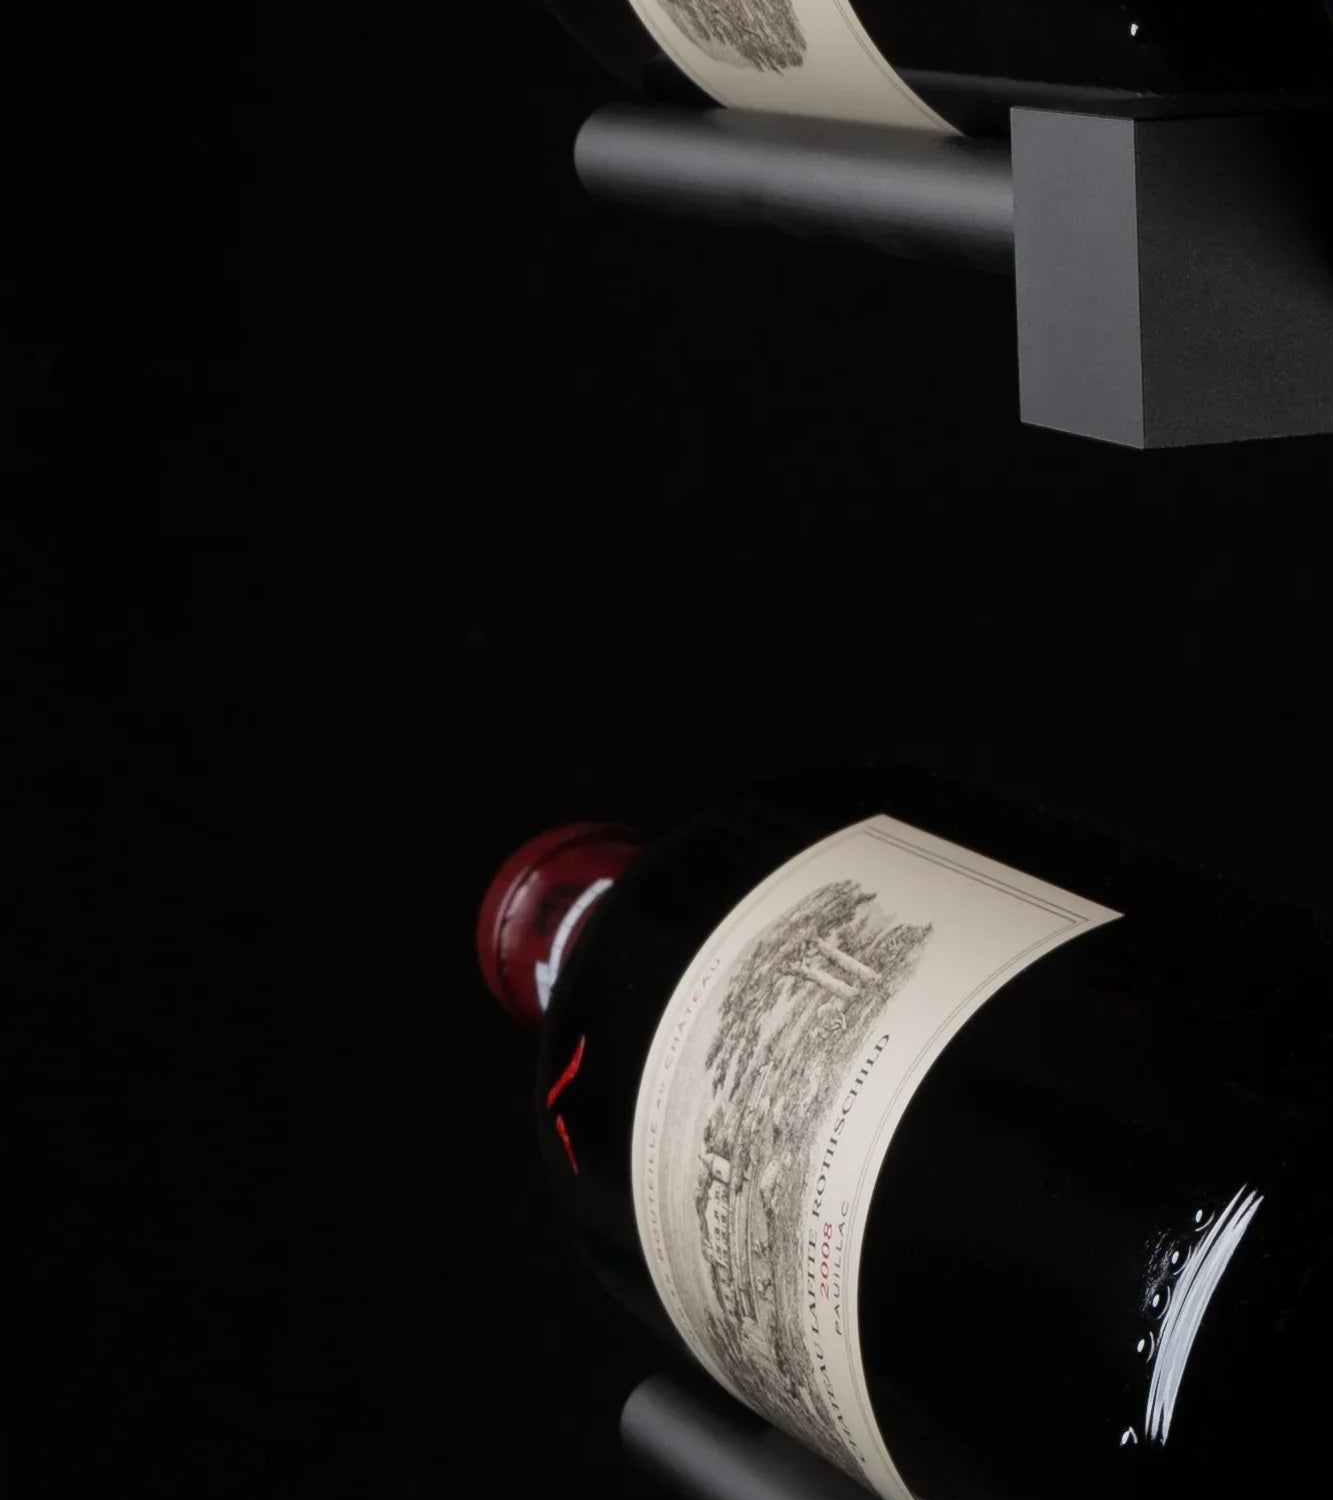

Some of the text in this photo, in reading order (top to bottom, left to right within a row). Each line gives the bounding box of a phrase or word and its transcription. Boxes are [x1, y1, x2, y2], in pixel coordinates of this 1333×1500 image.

[812, 1033, 890, 1219] ROTHSCHILD
[806, 1227, 820, 1335] LAFITE
[819, 1221, 834, 1301] 2008
[832, 1200, 850, 1337] PAUILLAC
